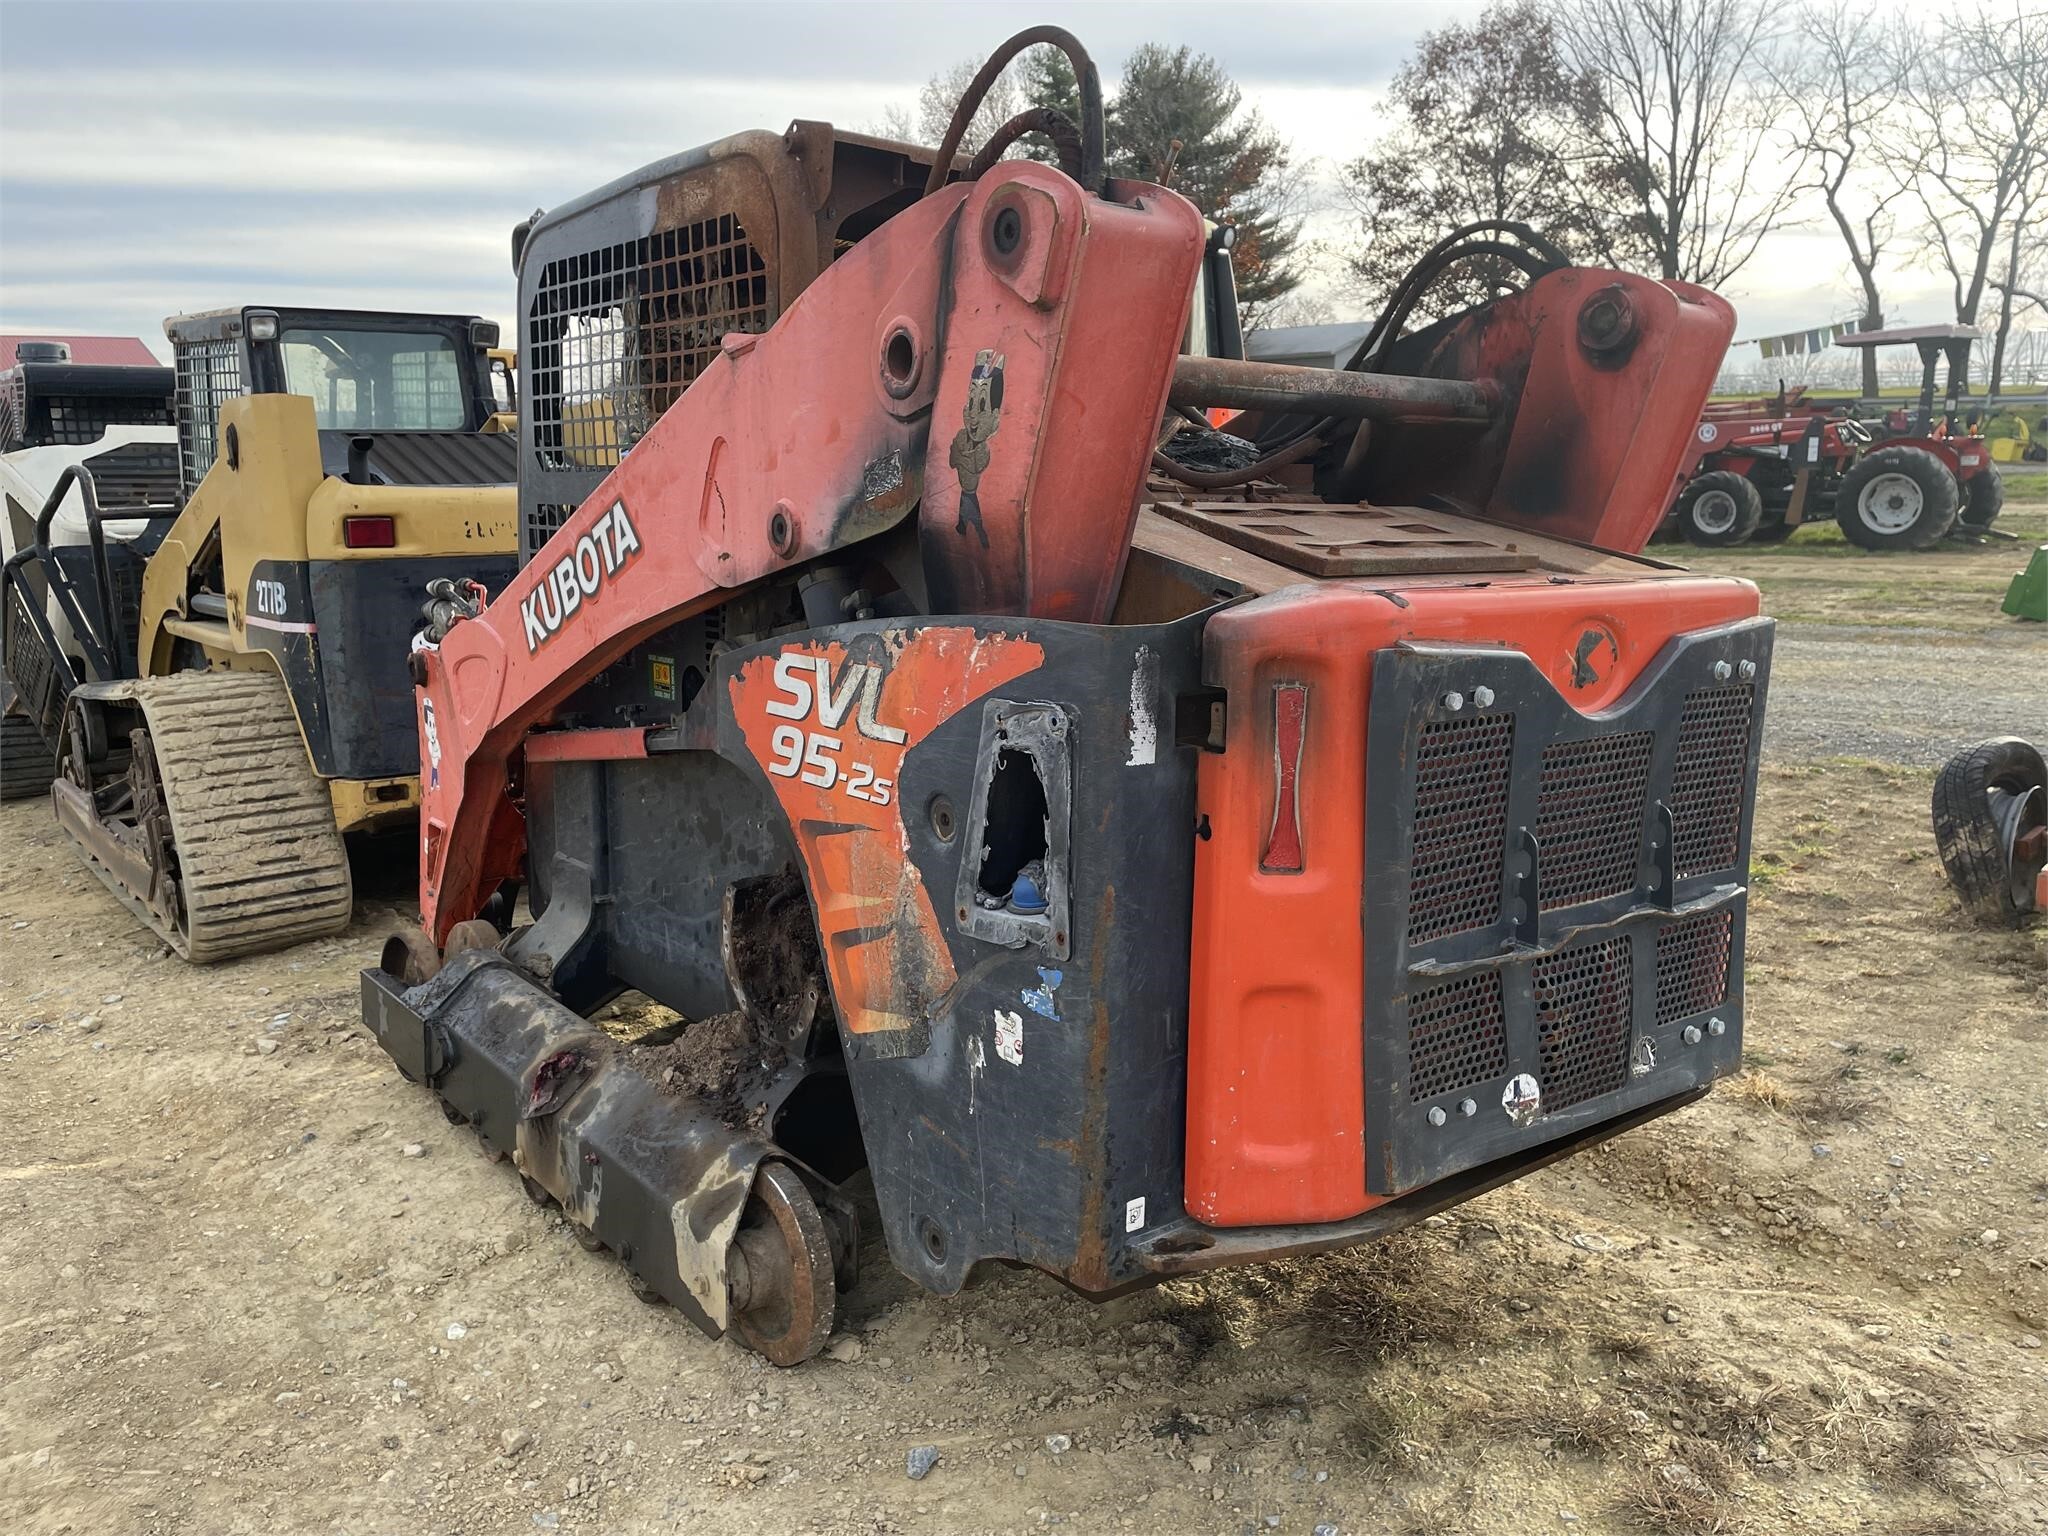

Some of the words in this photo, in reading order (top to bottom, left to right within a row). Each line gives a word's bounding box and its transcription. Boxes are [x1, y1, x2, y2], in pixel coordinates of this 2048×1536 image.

[255, 579, 287, 615] 277B
[520, 501, 639, 651] KUBOTA
[765, 652, 906, 744] SVL
